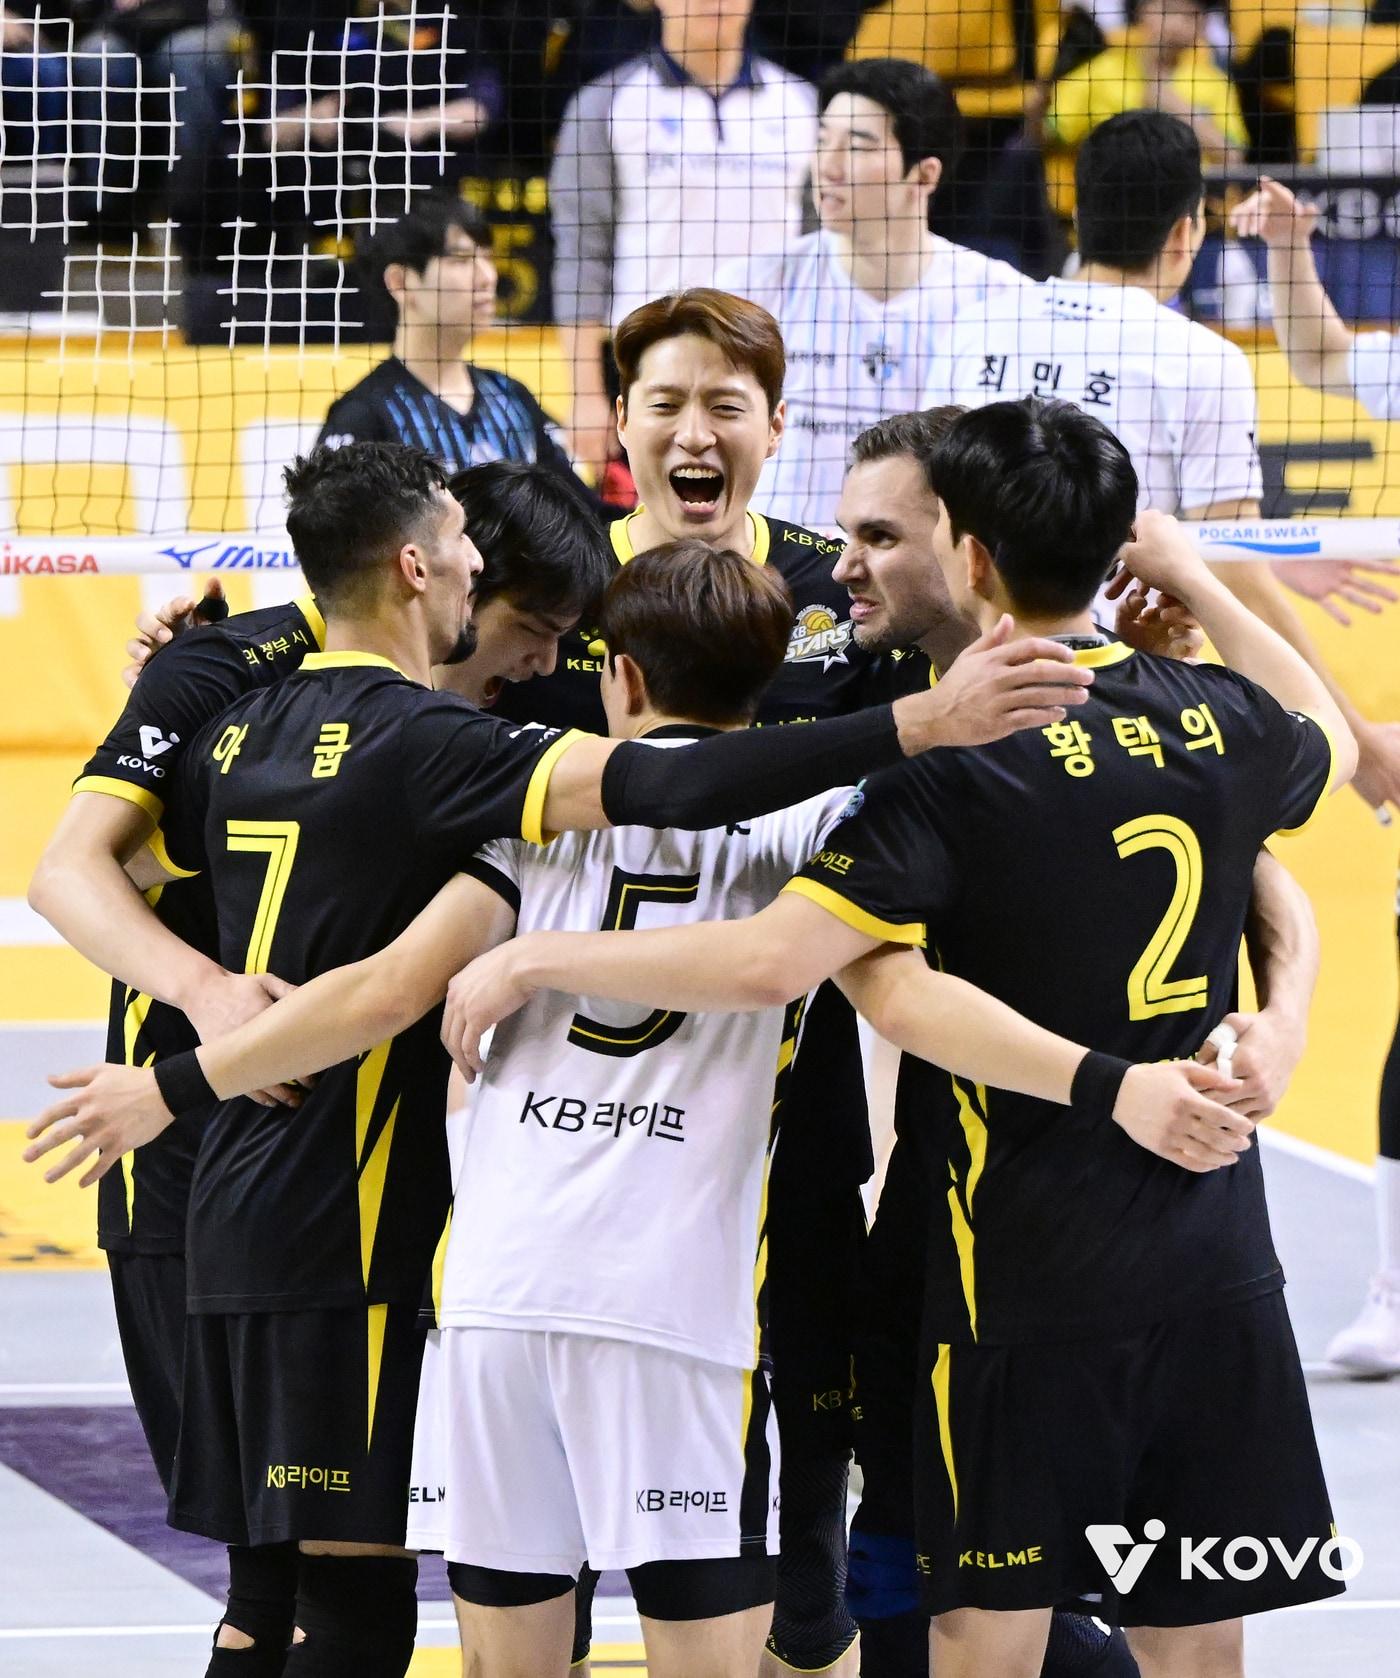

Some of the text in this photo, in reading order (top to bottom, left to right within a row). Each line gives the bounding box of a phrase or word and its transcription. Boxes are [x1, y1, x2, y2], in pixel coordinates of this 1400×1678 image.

[978, 354, 1116, 406] 최민호
[1199, 526, 1318, 539] POCARI SWEAT
[786, 623, 850, 659] STARS
[116, 754, 167, 779] KOVO
[1041, 703, 1225, 778] 황택의
[226, 819, 301, 975] 7
[1111, 813, 1209, 1022] 2
[566, 865, 701, 1058] 5
[958, 1545, 1043, 1569] KELME
